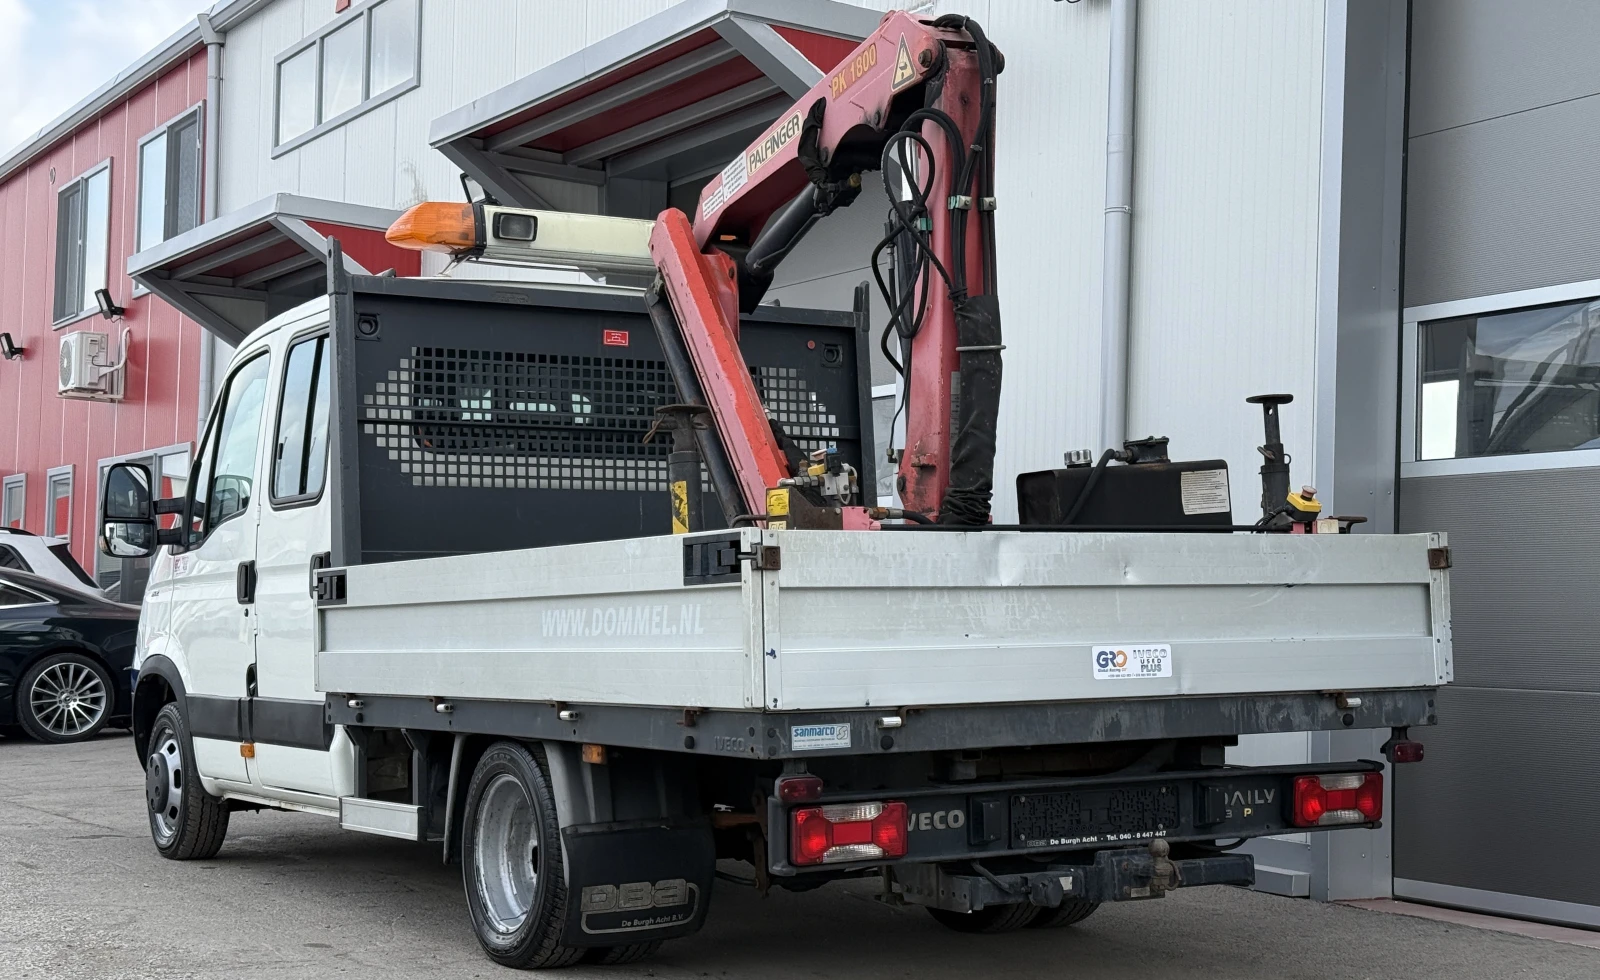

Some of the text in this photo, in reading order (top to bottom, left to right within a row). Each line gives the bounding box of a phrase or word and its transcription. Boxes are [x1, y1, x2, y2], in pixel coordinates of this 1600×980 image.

[832, 43, 877, 98] PK 1800
[749, 114, 800, 173] PALFINGER
[541, 603, 704, 637] WWW.DOMMEL.NL
[1096, 650, 1128, 668] GRO
[1133, 649, 1168, 659] IVECO
[1140, 664, 1162, 673] PLUS
[794, 726, 836, 737] sanmarco
[714, 735, 746, 751] IVECO
[1050, 838, 1060, 846] De
[1061, 837, 1081, 846] Burgh
[1082, 835, 1098, 844] Acht
[1119, 833, 1132, 841] 040
[1142, 831, 1154, 840] 447
[1154, 830, 1167, 839] 447
[621, 920, 632, 928] De
[633, 917, 655, 928] Burgh
[655, 915, 671, 924] Acht
